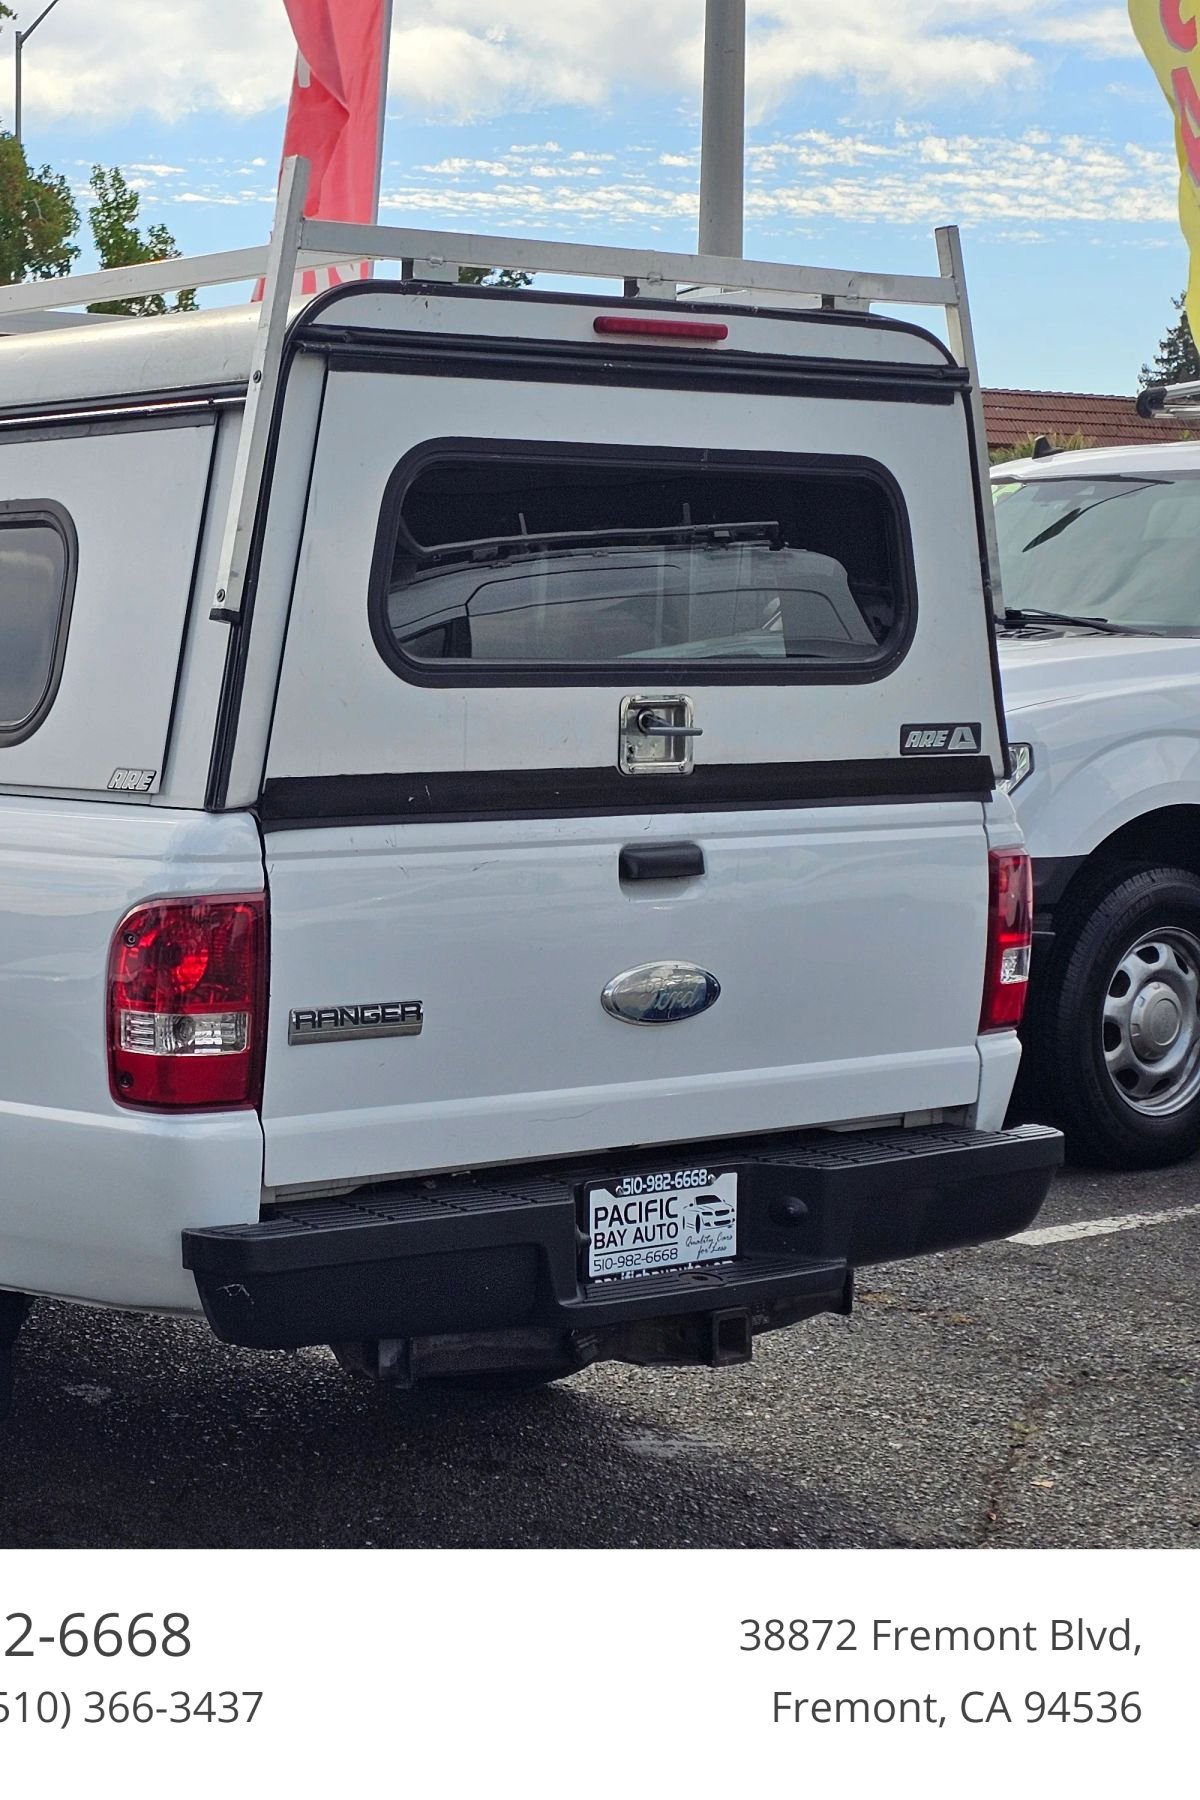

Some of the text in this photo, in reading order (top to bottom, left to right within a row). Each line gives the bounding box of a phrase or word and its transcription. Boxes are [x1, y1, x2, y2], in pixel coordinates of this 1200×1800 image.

[904, 730, 949, 748] ARE
[107, 768, 157, 792] ARE
[294, 1002, 421, 1030] RANGER
[622, 1169, 707, 1195] 510-982-6668
[594, 1196, 678, 1230] PACIFIC
[594, 1222, 678, 1250] BAY AUTO
[593, 1248, 678, 1272] 510-982-6668
